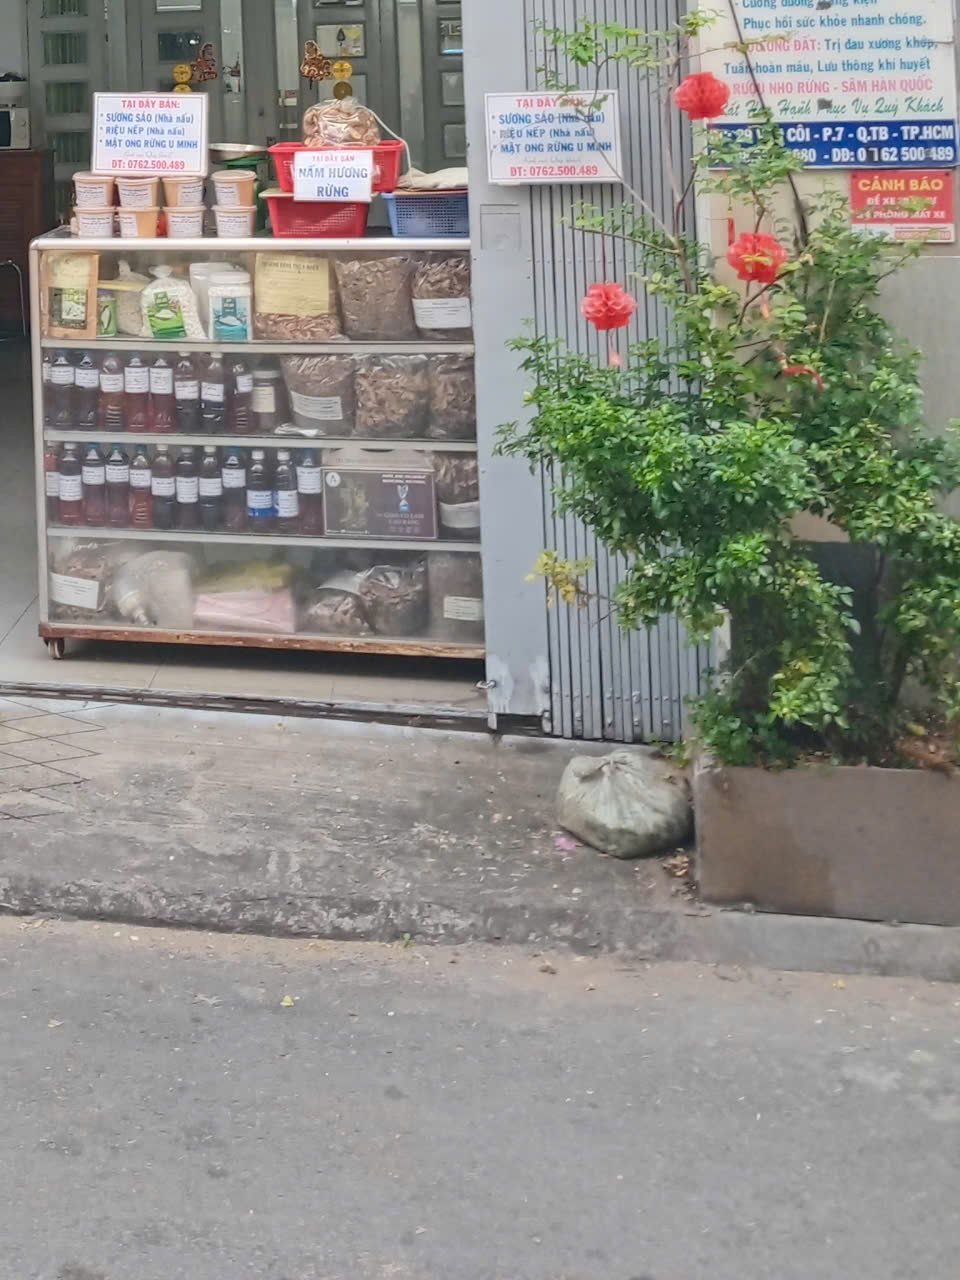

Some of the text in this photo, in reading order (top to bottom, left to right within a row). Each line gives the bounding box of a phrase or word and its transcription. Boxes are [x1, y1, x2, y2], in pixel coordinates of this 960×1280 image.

[743, 17, 771, 31] Phục
[851, 14, 884, 26] nhanh
[842, 59, 874, 73] thông
[769, 80, 793, 94] NHO
[786, 124, 811, 142] CÔI
[822, 127, 844, 141] P.7
[856, 126, 889, 143] Q.TB
[900, 125, 954, 141] TP.HCM
[125, 139, 141, 148] ONG
[169, 140, 175, 148] U
[177, 140, 198, 149] MINH
[525, 142, 544, 153] ONG
[577, 142, 583, 152] U
[901, 147, 925, 161] 500
[128, 160, 185, 169] 0762.500.489
[299, 164, 368, 178] NẤM HƯƠNG
[530, 165, 598, 176] 0762.500.489
[317, 183, 349, 197] RỪNG
[858, 176, 944, 191] CẢNH BÁO
